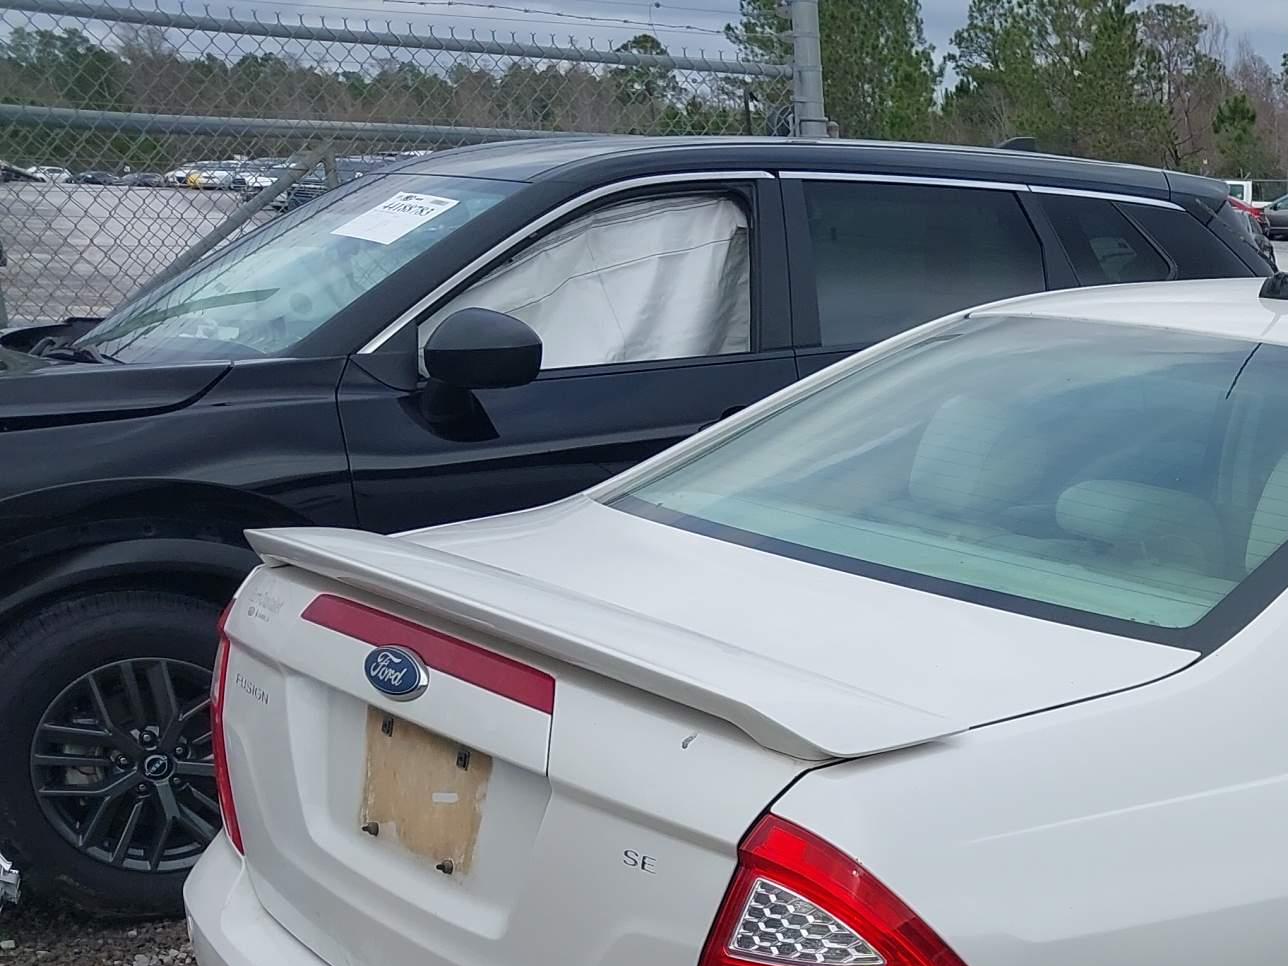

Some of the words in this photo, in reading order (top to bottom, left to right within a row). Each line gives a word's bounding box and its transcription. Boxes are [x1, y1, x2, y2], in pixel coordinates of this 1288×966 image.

[370, 651, 407, 686] Ford
[235, 673, 269, 705] FUSION
[623, 849, 657, 874] SE
